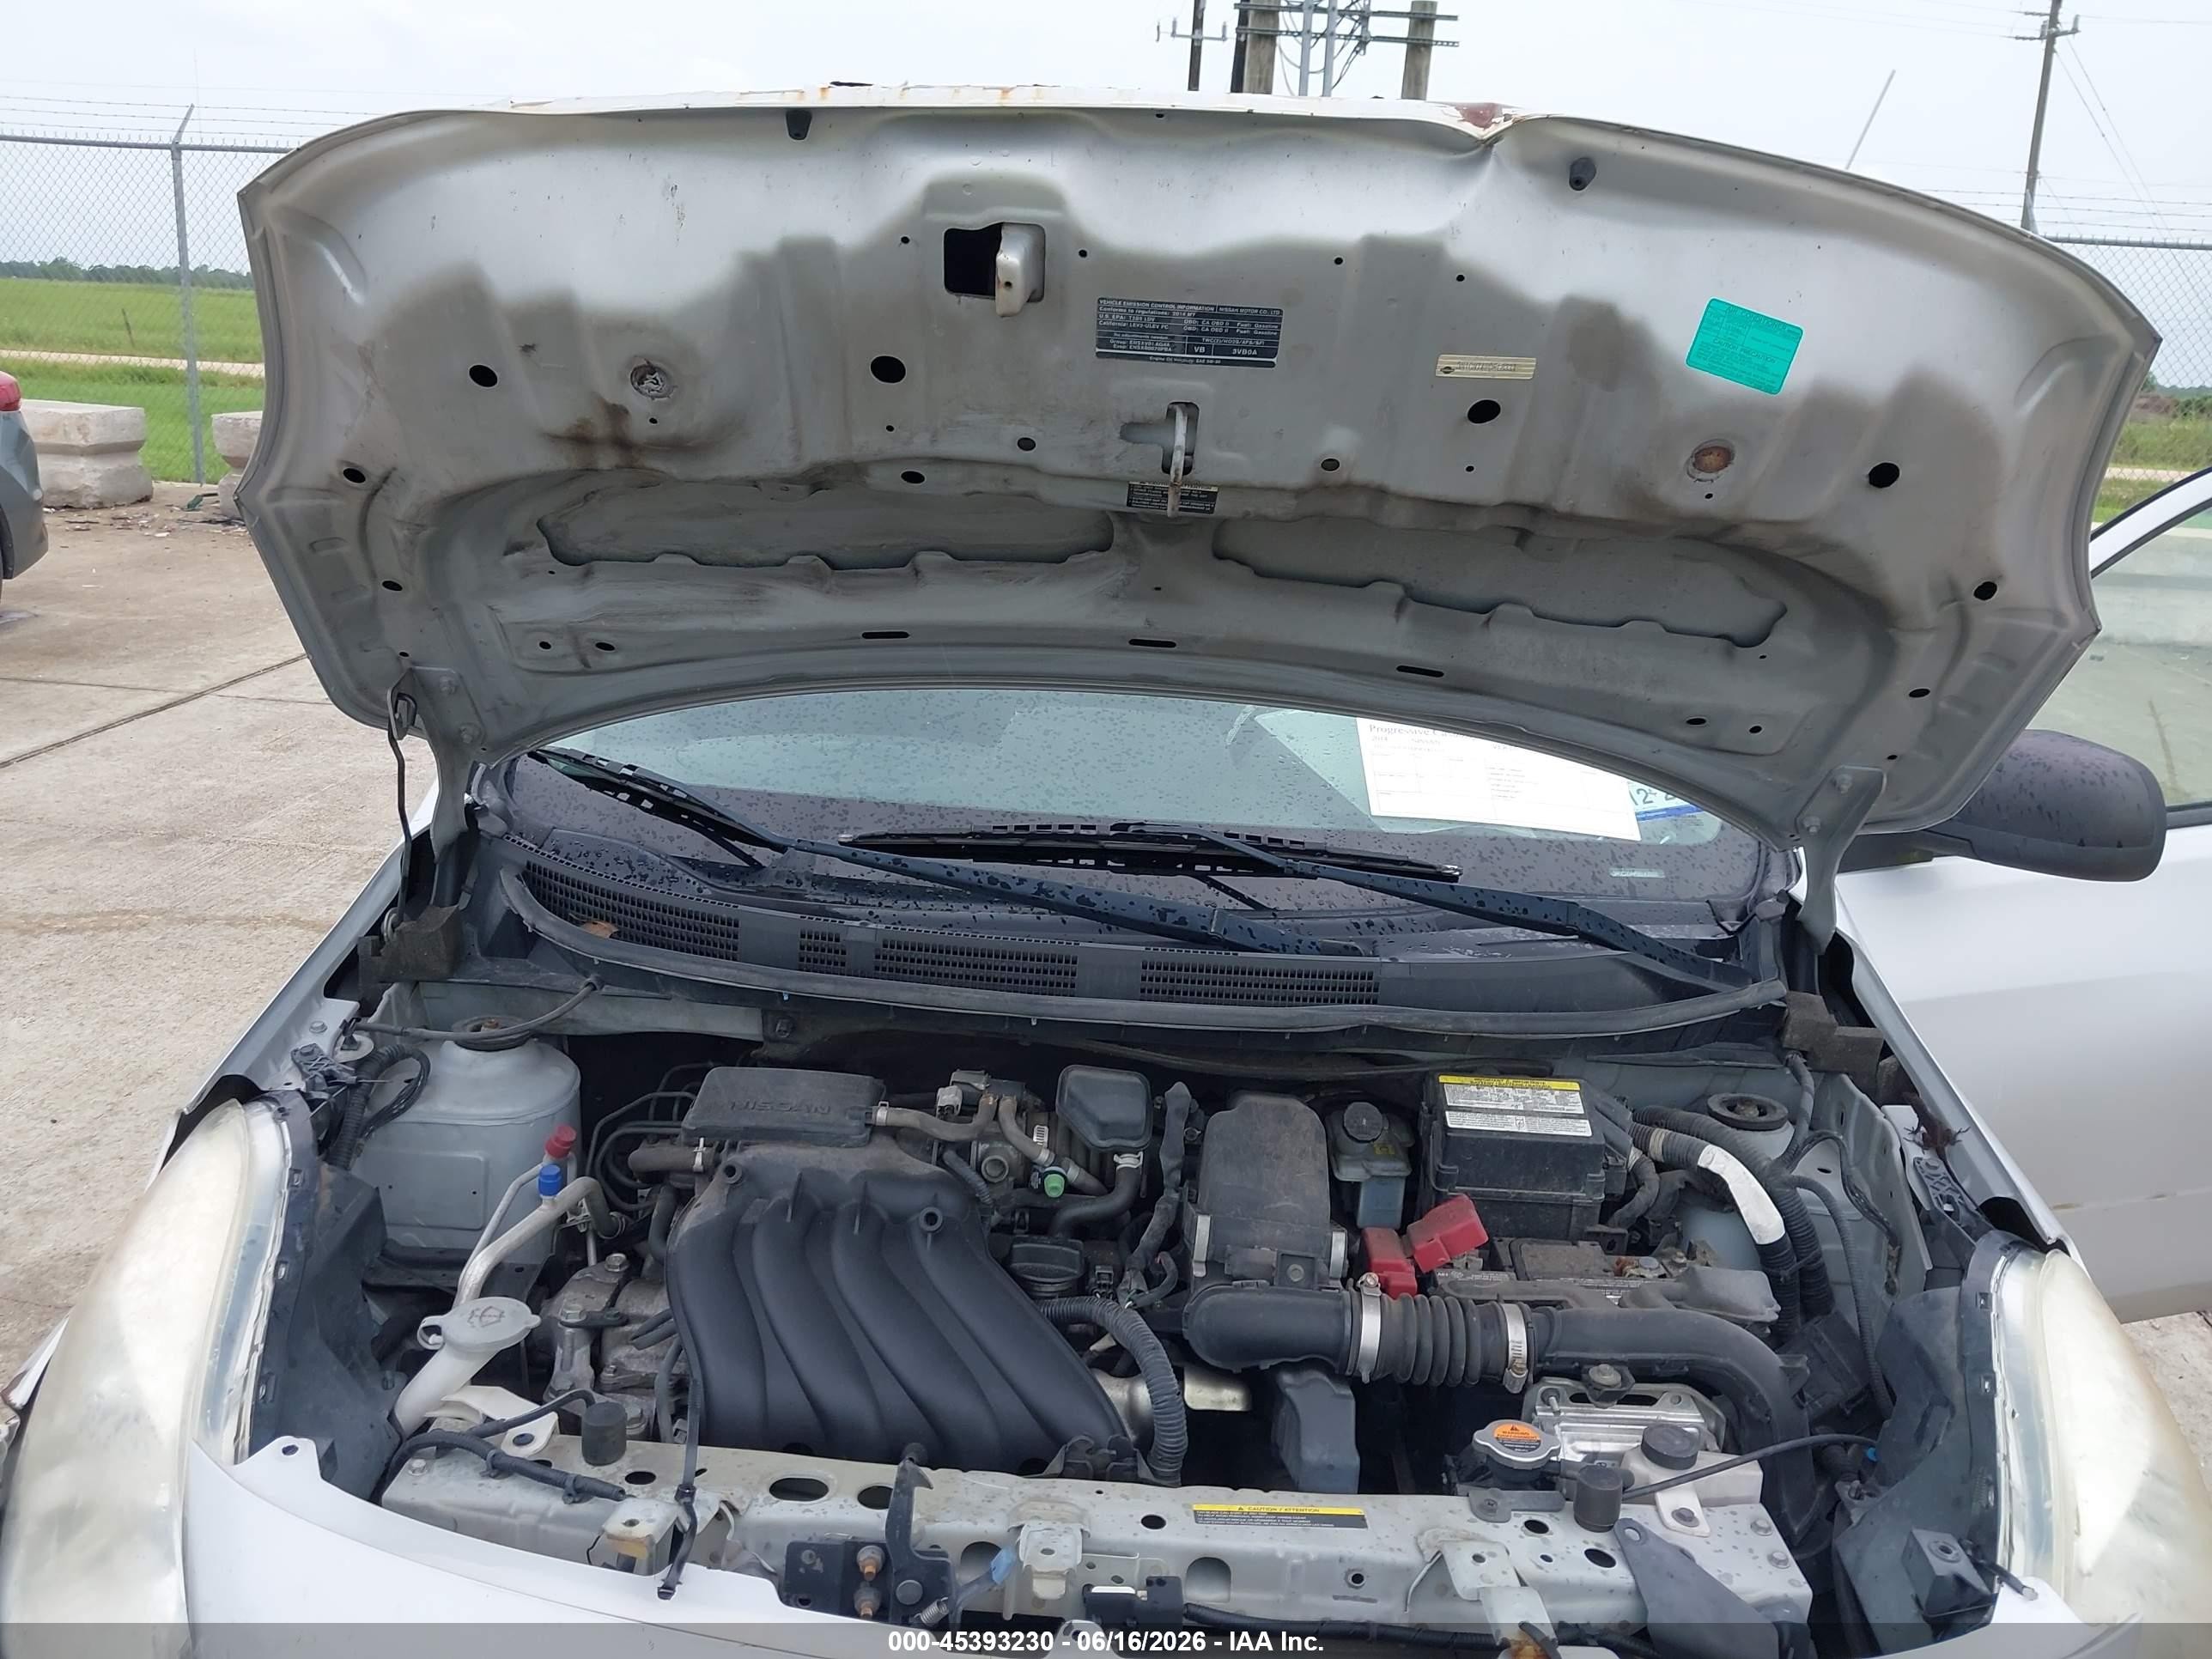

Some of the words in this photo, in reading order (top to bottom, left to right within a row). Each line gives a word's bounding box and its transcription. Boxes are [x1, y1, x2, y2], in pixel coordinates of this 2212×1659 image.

[1726, 307, 1739, 316] AIR
[1741, 310, 1788, 331] CONDITIONER
[1713, 337, 1738, 352] CAUTION
[1740, 349, 1777, 364] PRECAUTION
[1369, 724, 1430, 736] Progressive
[729, 1099, 831, 1115] NISSAN
